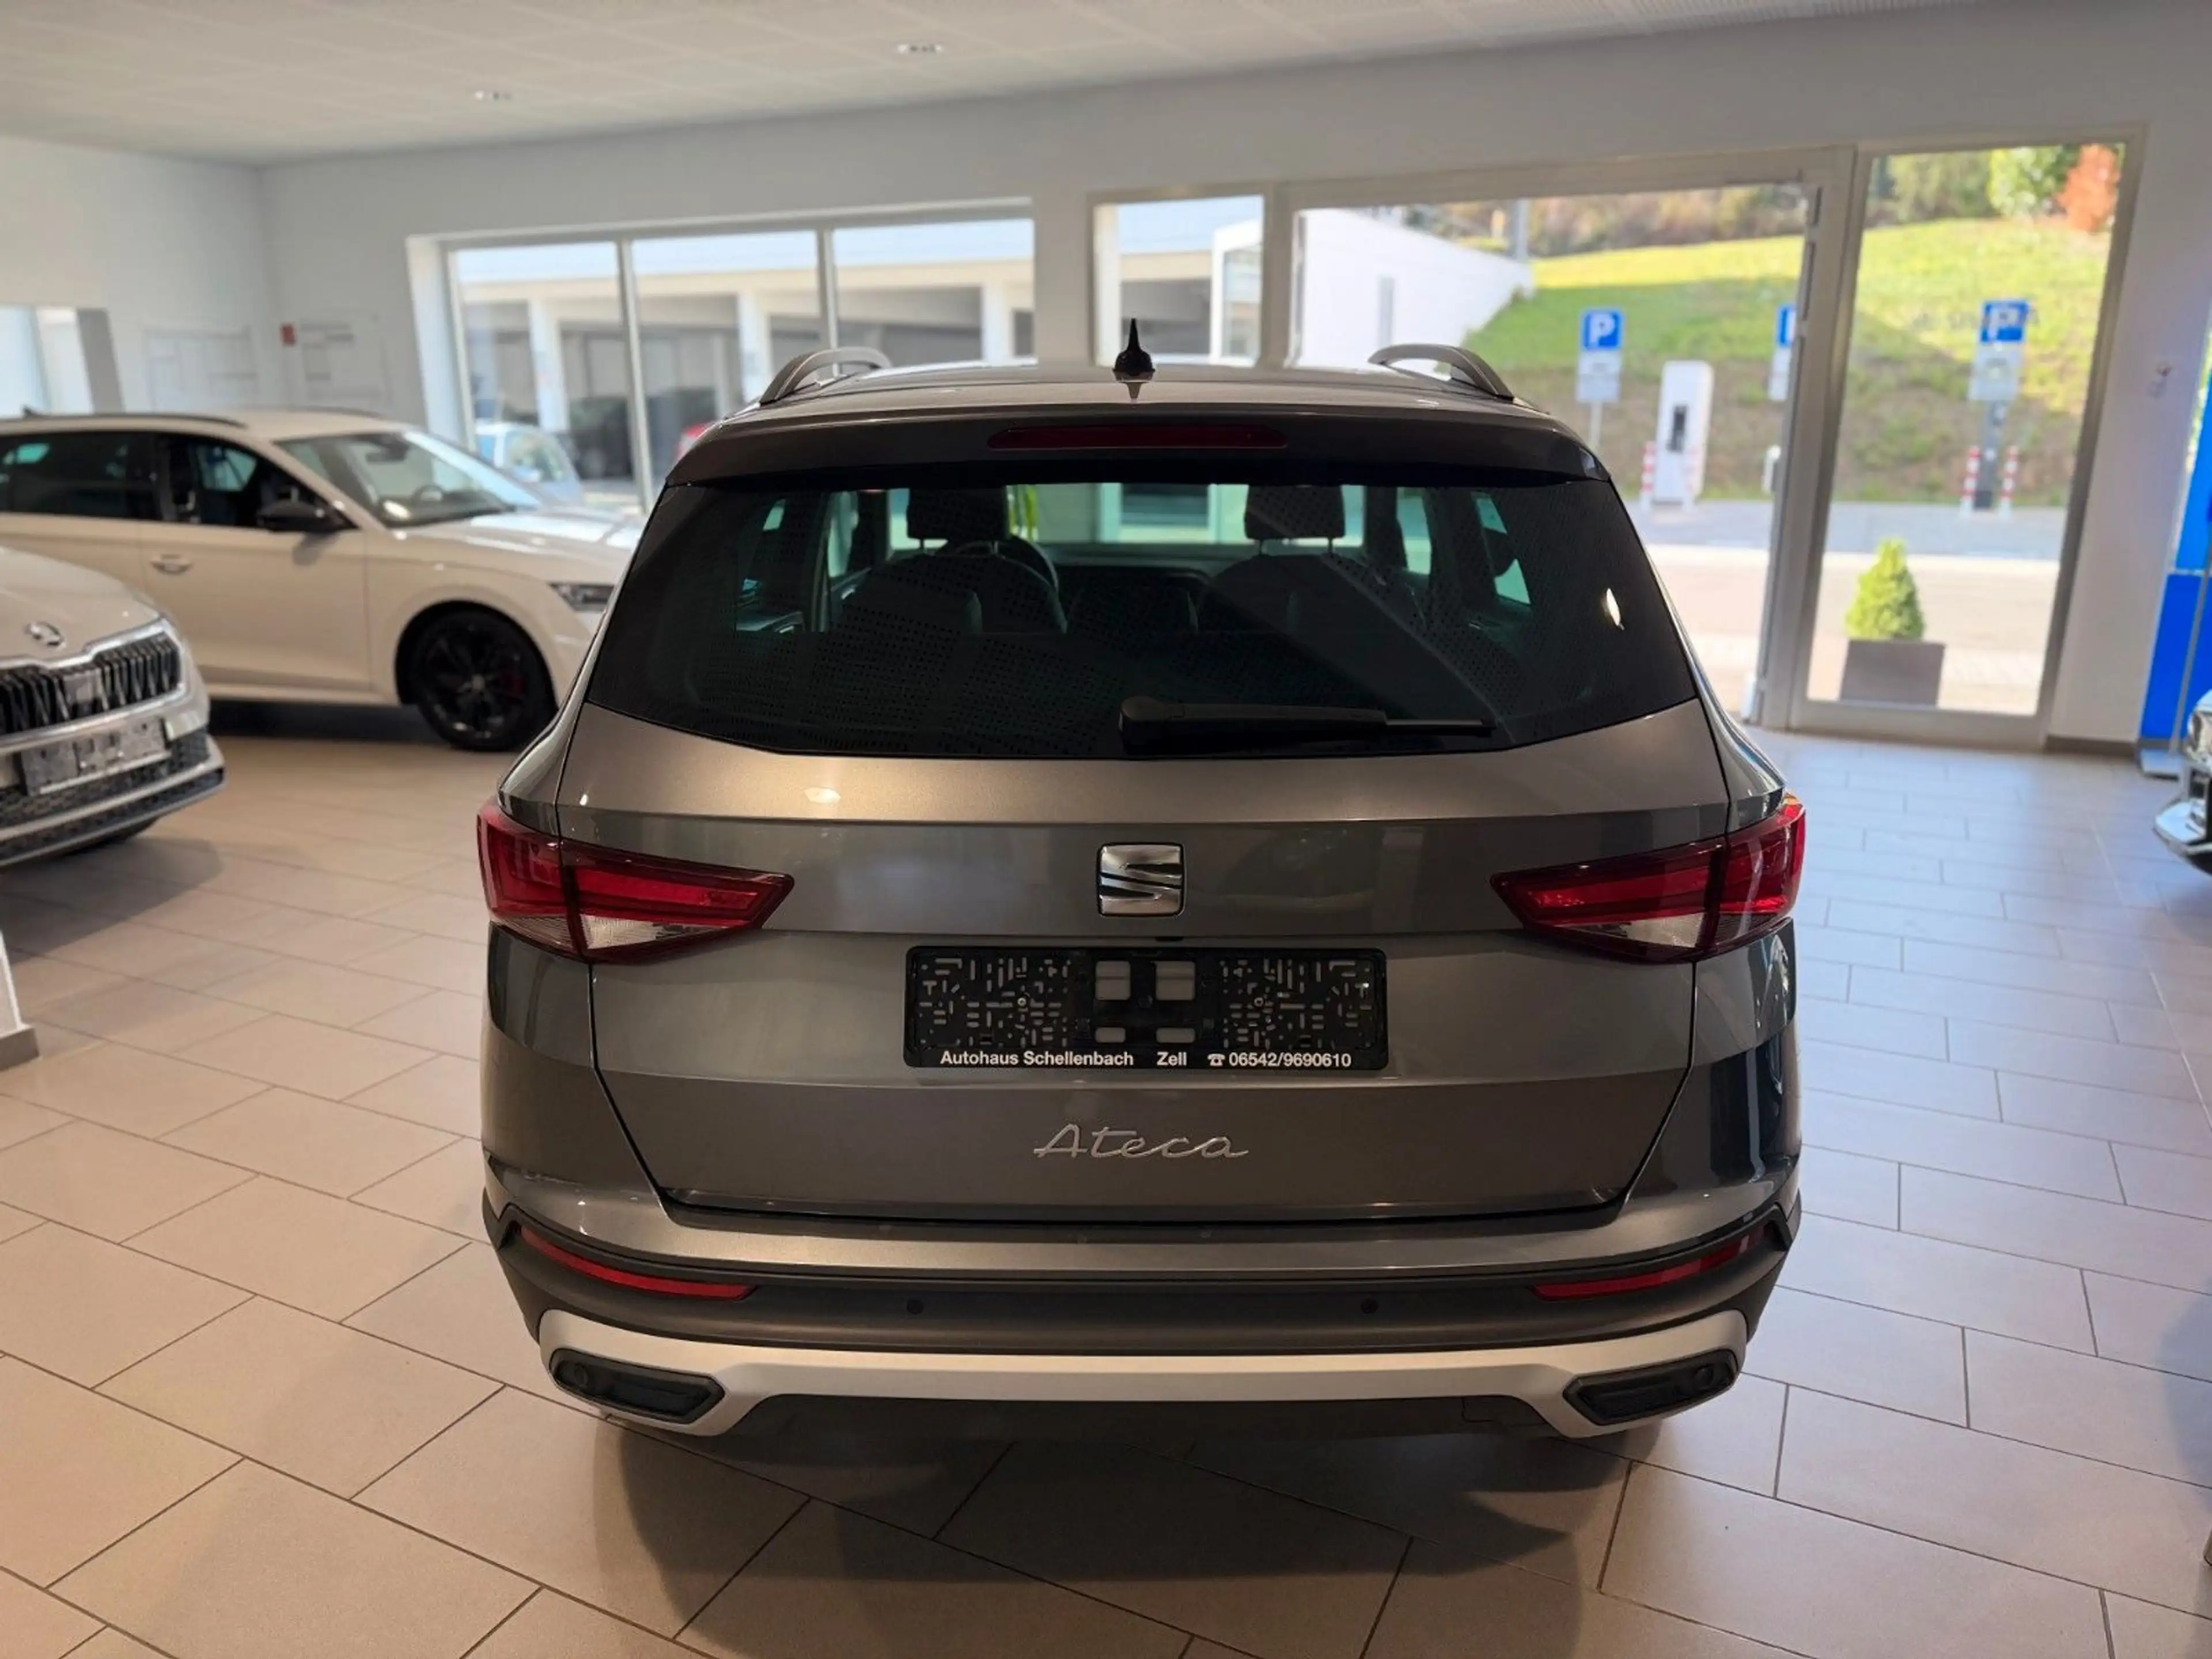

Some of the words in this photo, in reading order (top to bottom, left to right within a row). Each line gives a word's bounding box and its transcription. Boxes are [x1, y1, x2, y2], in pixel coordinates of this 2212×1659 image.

[1589, 312, 1616, 347] P
[940, 1050, 1019, 1065] Autohaus
[1022, 1050, 1134, 1066] Schellenbach
[1156, 1051, 1188, 1066] Zell
[1228, 1051, 1352, 1067] 06542/9690610
[1033, 1123, 1250, 1158] Ateca
